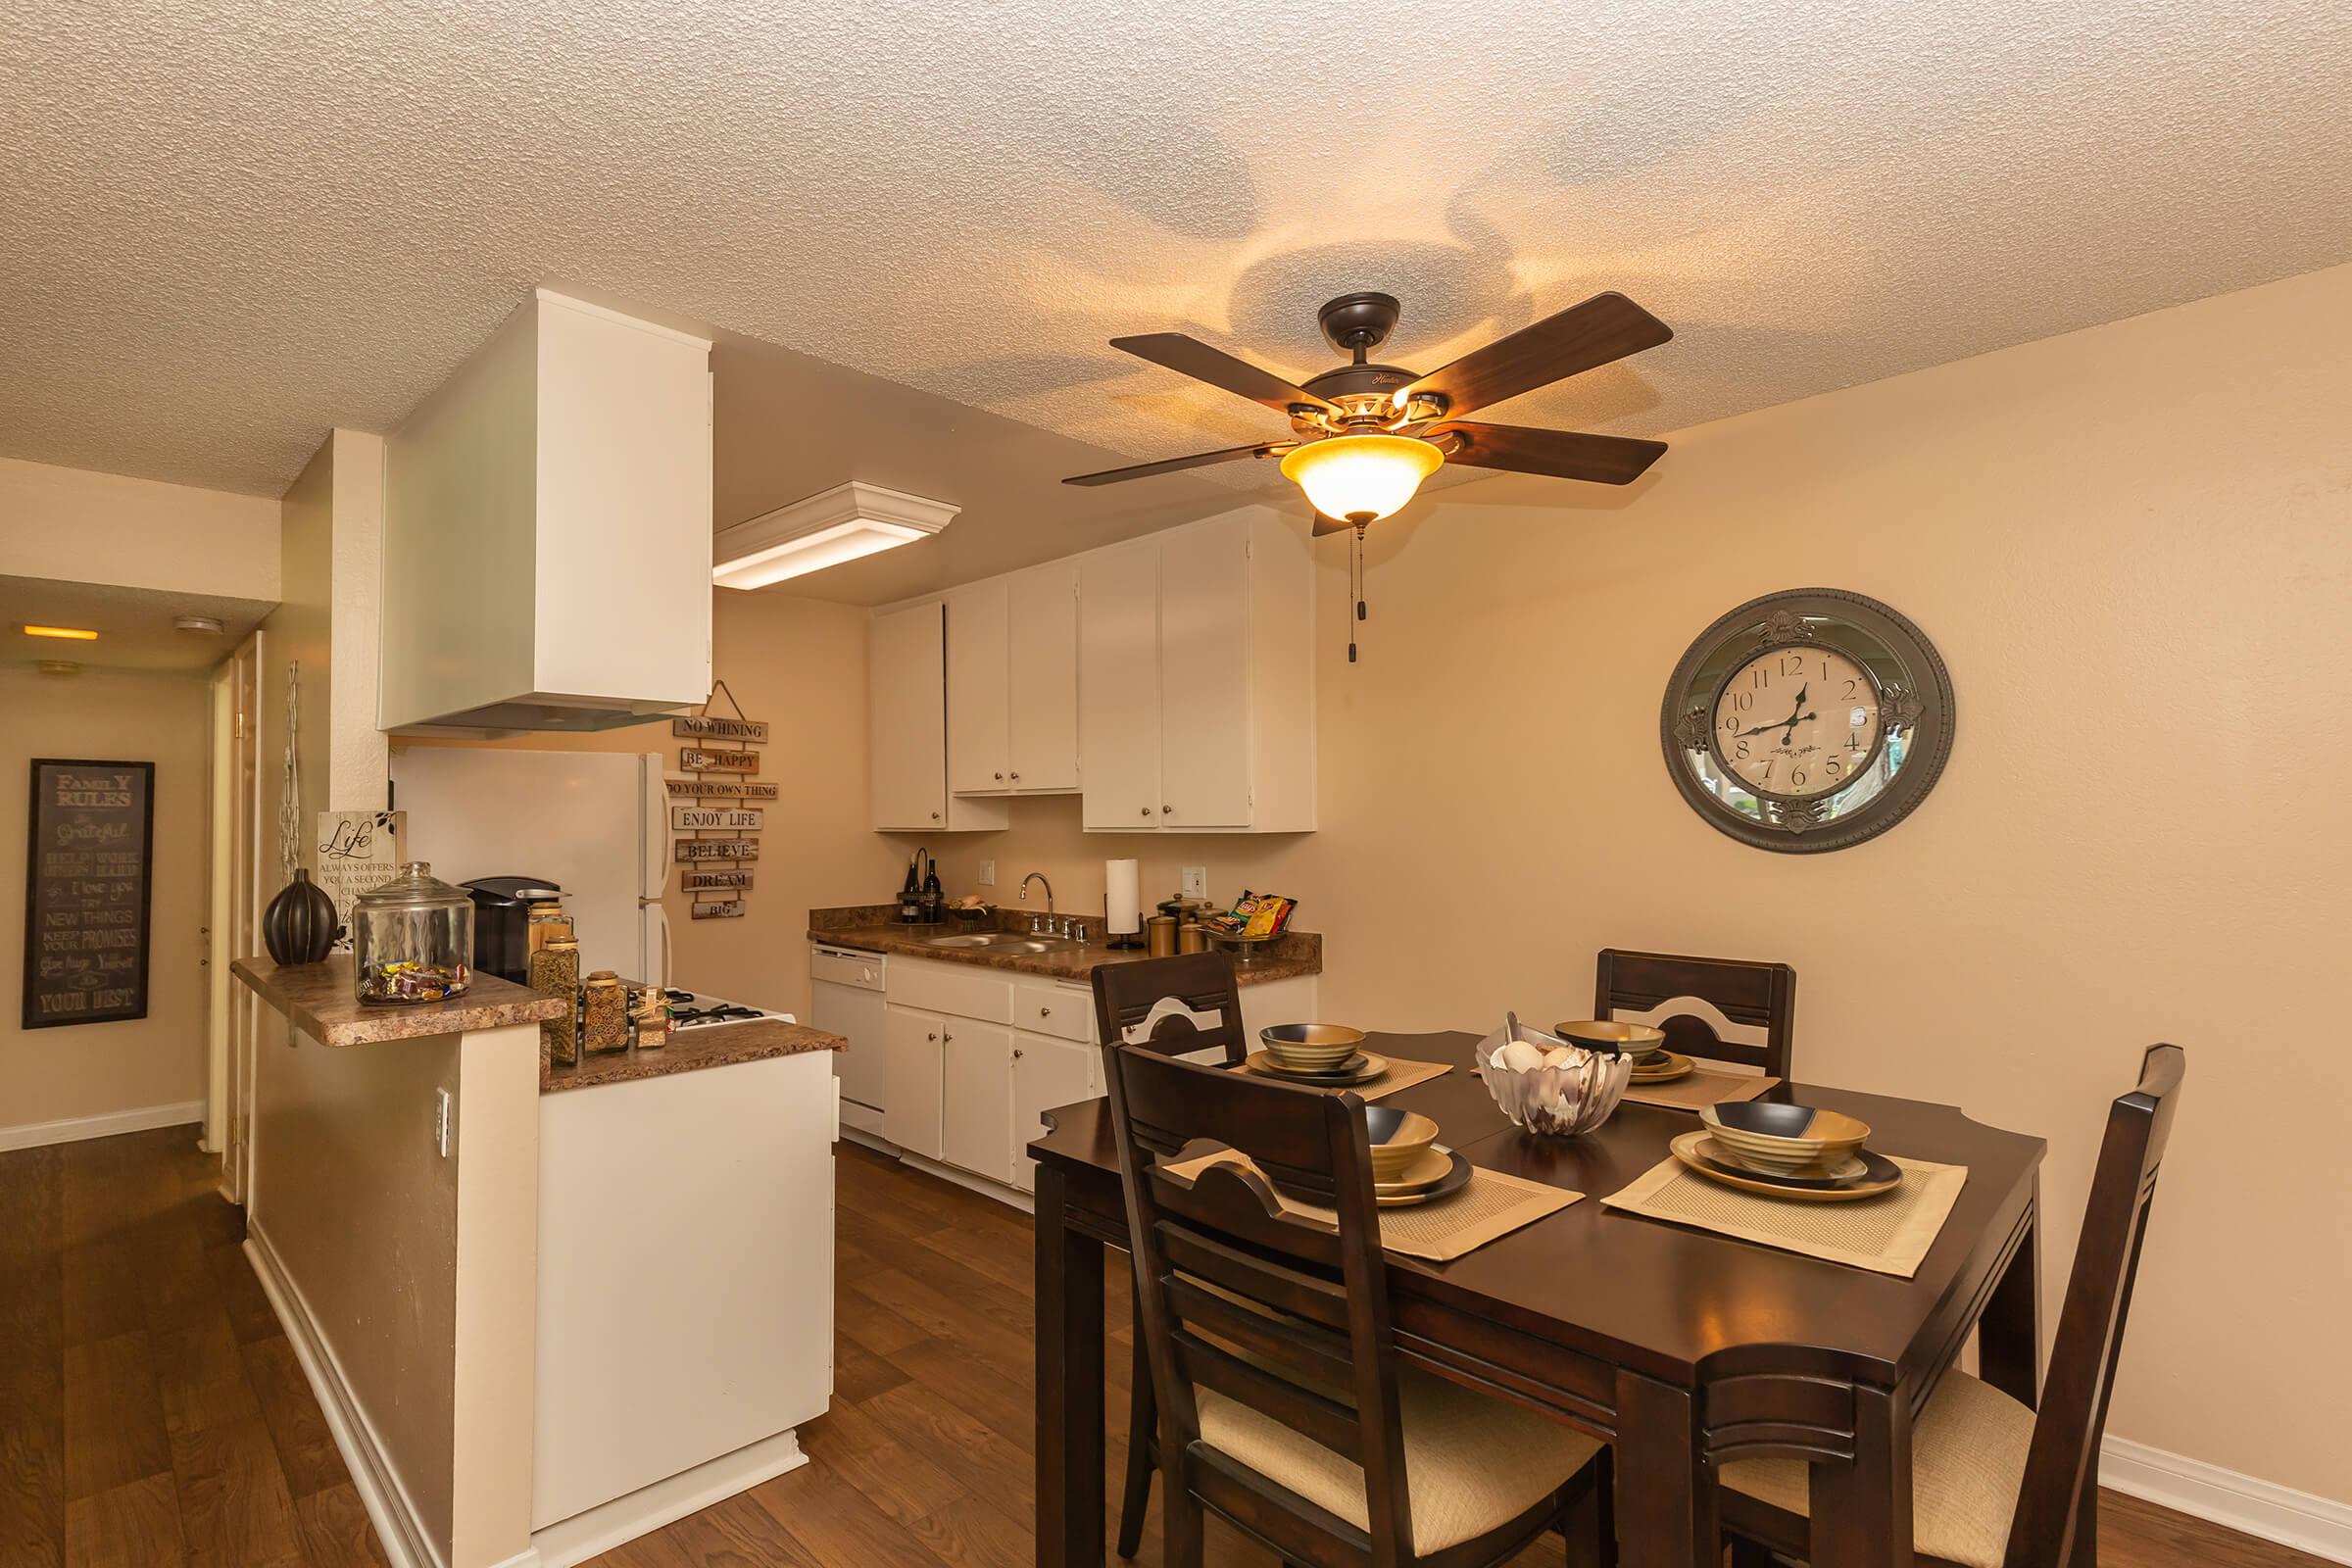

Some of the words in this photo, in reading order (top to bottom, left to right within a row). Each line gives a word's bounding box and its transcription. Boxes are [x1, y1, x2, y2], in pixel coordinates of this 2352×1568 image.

[1781, 656, 1802, 677] 12
[1822, 662, 1828, 681] 1
[1753, 669, 1768, 689] 11
[1841, 679, 1857, 701] 2
[1733, 691, 1753, 711] 10
[1853, 706, 1867, 726] 3
[683, 719, 703, 732] NO
[705, 721, 761, 737] WHINING
[1726, 716, 1740, 737] 9
[1736, 740, 1750, 760] 8
[1843, 732, 1860, 752] 4
[686, 752, 703, 764] BE
[713, 754, 755, 767] HAPPY
[1825, 755, 1841, 774] 5
[1760, 760, 1775, 779] 7
[1791, 763, 1806, 786] 6
[684, 783, 714, 795] YOUR
[717, 784, 742, 795] OWN
[745, 785, 776, 796] THING
[56, 791, 132, 808] RULES
[682, 812, 722, 826] ENJOY
[729, 812, 756, 826] LIFE
[318, 819, 373, 859] Life
[688, 844, 750, 858] BELIEVE
[319, 863, 360, 872] ALWAYS
[361, 862, 394, 872] OFFERS
[346, 875, 353, 884] A
[354, 874, 392, 884] SECOND
[692, 874, 746, 887] DREAM
[46, 912, 78, 926] NEW
[81, 908, 134, 926] THINGS
[710, 905, 731, 915] BIG
[42, 930, 79, 942] KEEP
[81, 928, 137, 950] PROMISES
[42, 940, 78, 952] YOUR
[40, 992, 87, 1013] YOUR
[93, 988, 134, 1009] BEST
